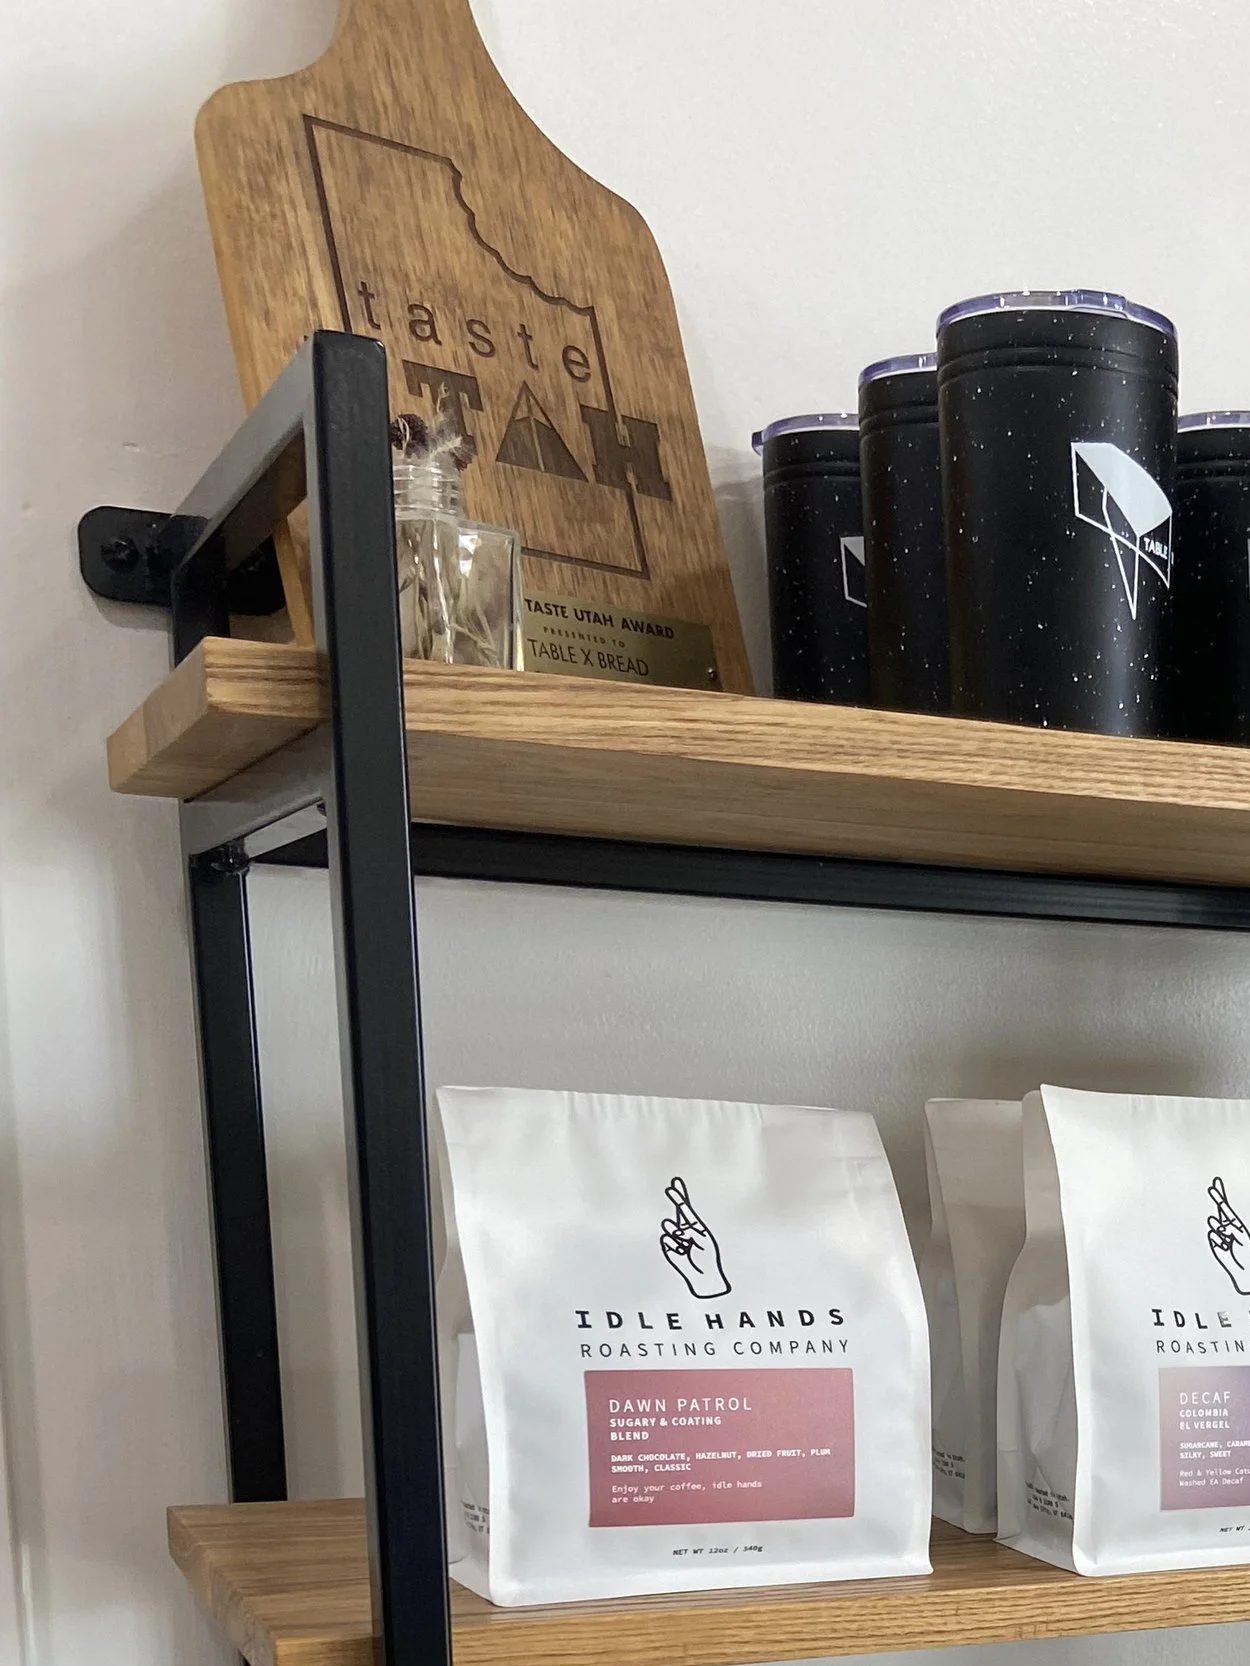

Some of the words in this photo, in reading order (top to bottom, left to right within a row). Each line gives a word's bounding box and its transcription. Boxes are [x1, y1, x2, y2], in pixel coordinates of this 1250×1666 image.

[358, 281, 592, 383] taste
[1143, 537, 1168, 559] TABLE
[524, 598, 569, 619] TASTE
[573, 607, 614, 628] UTAH
[621, 618, 674, 639] AWARD
[543, 626, 606, 644] PRESENTED
[612, 638, 625, 648] TO
[527, 638, 577, 664] TABLE
[581, 649, 594, 667] X
[598, 651, 649, 676] BREAD
[575, 1310, 682, 1330] IDLE
[705, 1309, 844, 1329] HANDS
[1151, 1309, 1232, 1329] IDLE
[580, 1342, 716, 1358] ROASTING
[733, 1339, 848, 1355] COMPANY
[609, 1399, 667, 1413] DAWN
[677, 1397, 752, 1412] PATROL
[1179, 1391, 1231, 1405] DECAF
[1179, 1409, 1229, 1418] COLOMBIA
[609, 1418, 656, 1427] SUGARY
[659, 1418, 668, 1427] &
[672, 1416, 722, 1426] COATING
[1179, 1422, 1190, 1430] EL
[1194, 1420, 1230, 1429] VERGEL
[610, 1432, 649, 1441] BLEND
[611, 1454, 633, 1462] DARK
[637, 1453, 691, 1463] CHOCOLATE,
[696, 1451, 742, 1461] HAZELNUT,
[746, 1450, 772, 1458] DRIED
[776, 1449, 806, 1459] FRUIT,
[611, 1464, 649, 1474] SMOOTH,
[654, 1463, 692, 1472] CLASSIC
[1205, 1468, 1231, 1476] Yellow
[611, 1485, 639, 1494] Enjoy
[643, 1485, 664, 1493] your
[670, 1482, 706, 1491] coffee,
[712, 1481, 732, 1490] idle
[736, 1480, 763, 1488] hands
[1179, 1478, 1206, 1486] Washed
[1222, 1477, 1244, 1485] Decaf
[633, 1495, 655, 1504] okay
